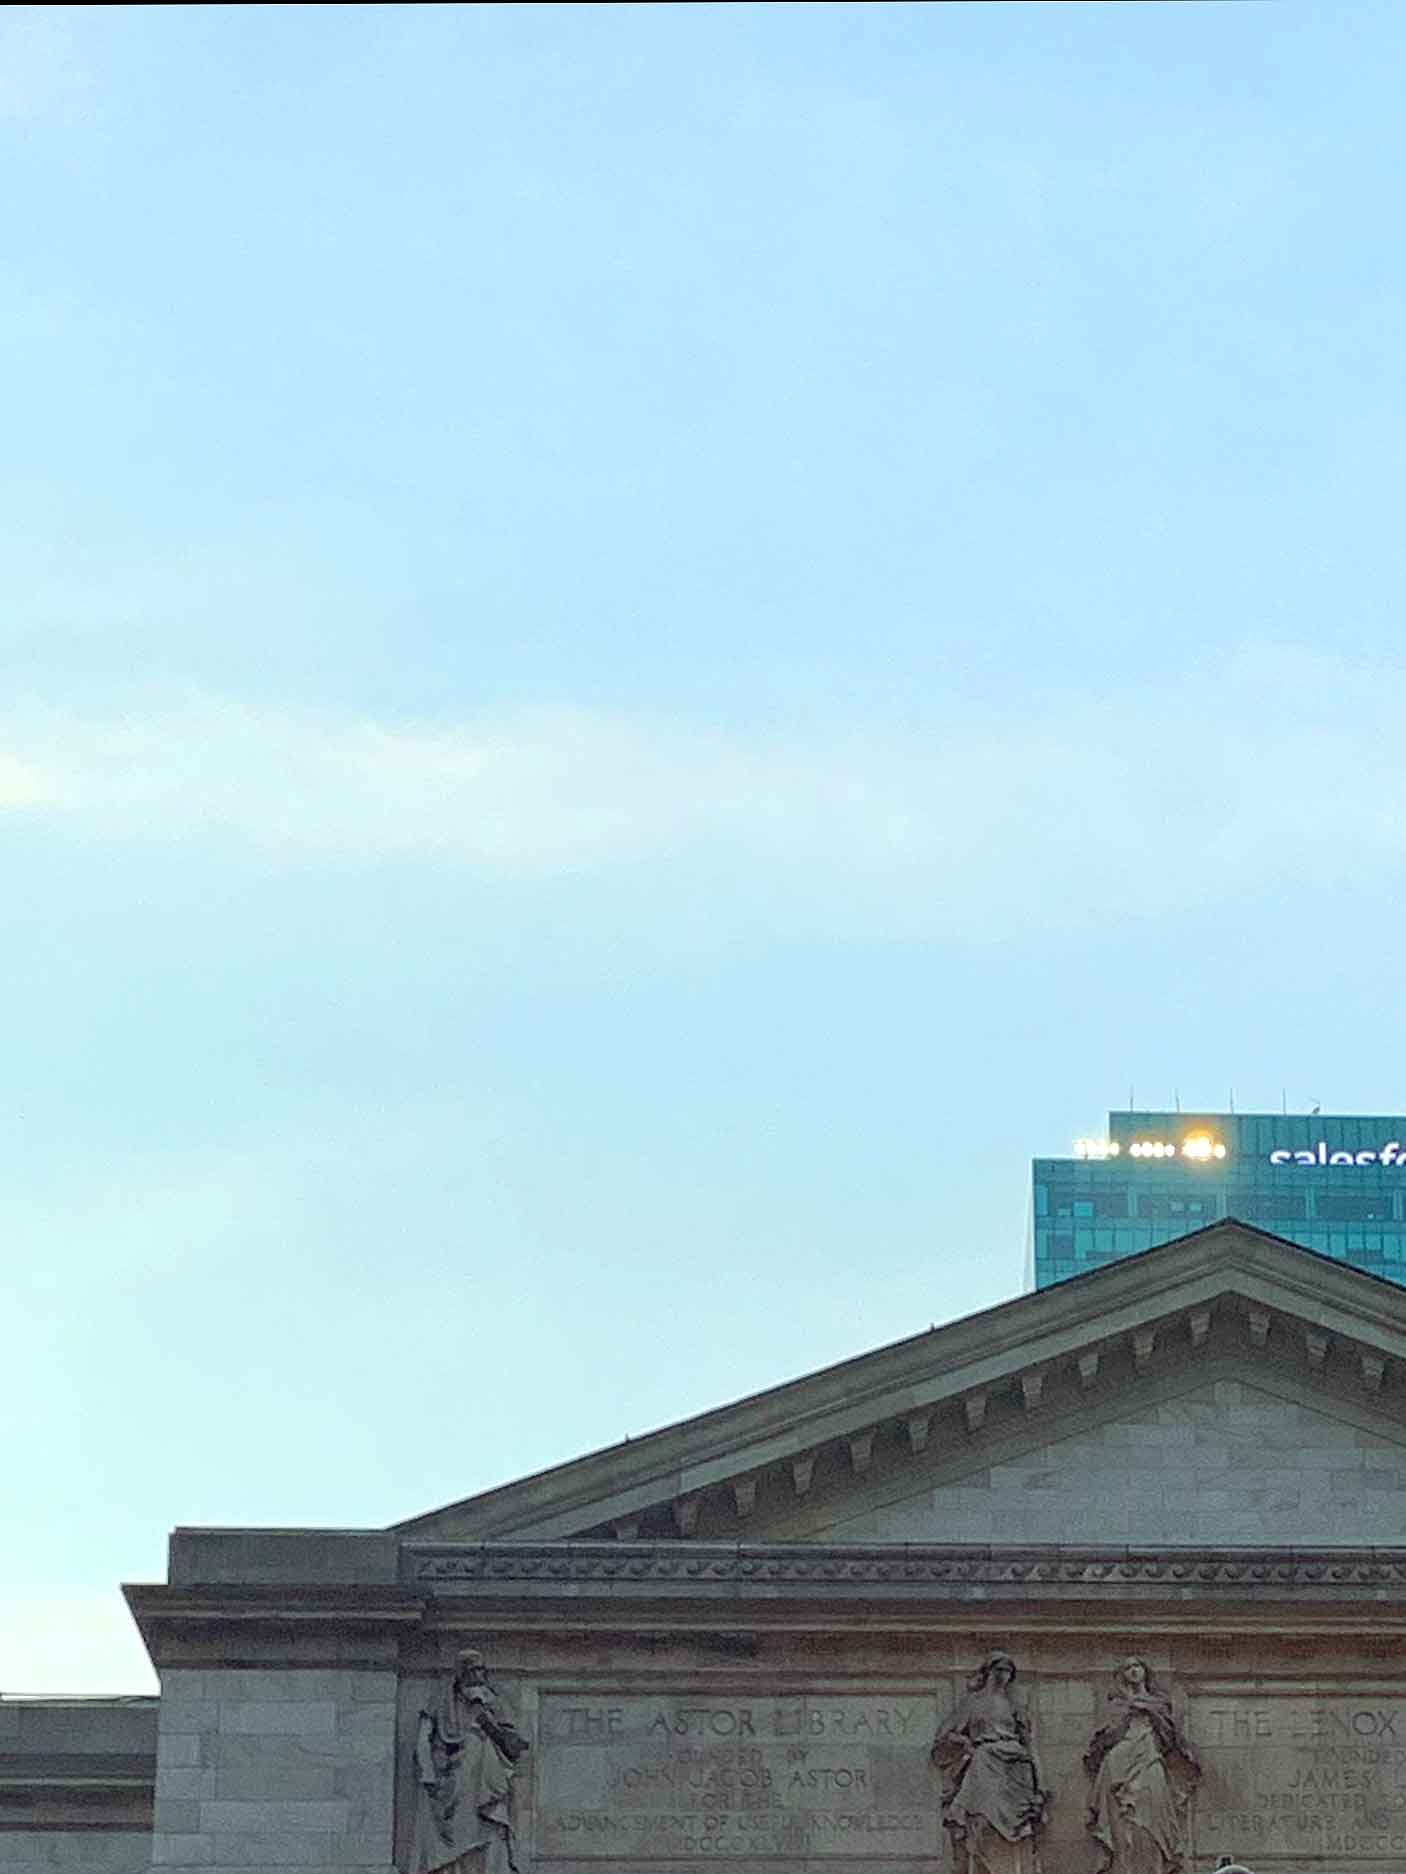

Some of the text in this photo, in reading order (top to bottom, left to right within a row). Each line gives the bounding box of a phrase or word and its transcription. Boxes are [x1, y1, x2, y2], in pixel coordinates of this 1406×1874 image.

[562, 1708, 914, 1737] THE ASTOR LIBRARY
[1209, 1711, 1273, 1737] THE
[1291, 1711, 1398, 1737] LENOX
[689, 1767, 773, 1788] JACOB
[788, 1767, 869, 1788] ASTOR
[1288, 1768, 1372, 1789] JAMES
